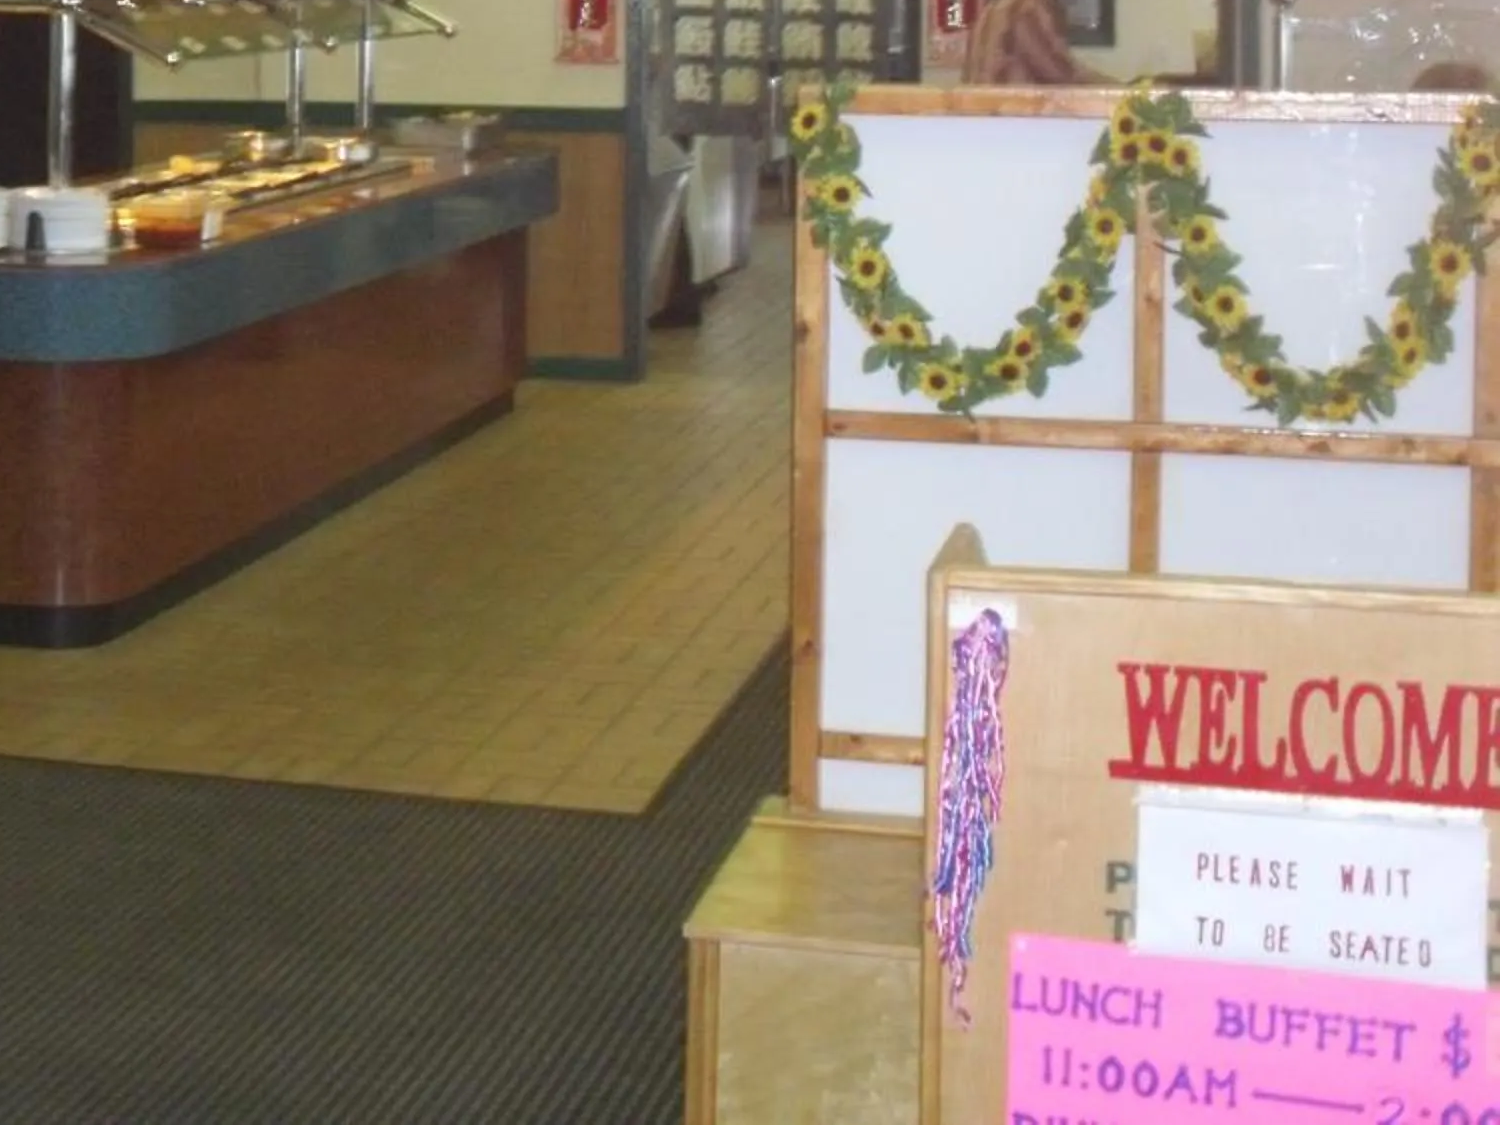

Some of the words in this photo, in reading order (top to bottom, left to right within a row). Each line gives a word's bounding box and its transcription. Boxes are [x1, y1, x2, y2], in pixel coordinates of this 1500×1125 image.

[1110, 661, 1500, 809] WELCOME
[1196, 852, 1298, 890] PLEASE
[1340, 864, 1411, 898] WAIT
[1196, 916, 1224, 947] TO
[1263, 924, 1291, 953] BE
[1328, 929, 1432, 968] SEATED
[1011, 972, 1163, 1029] LUNCH
[1214, 999, 1417, 1062] BUFFET
[1043, 1045, 1237, 1109] 11:00AM
